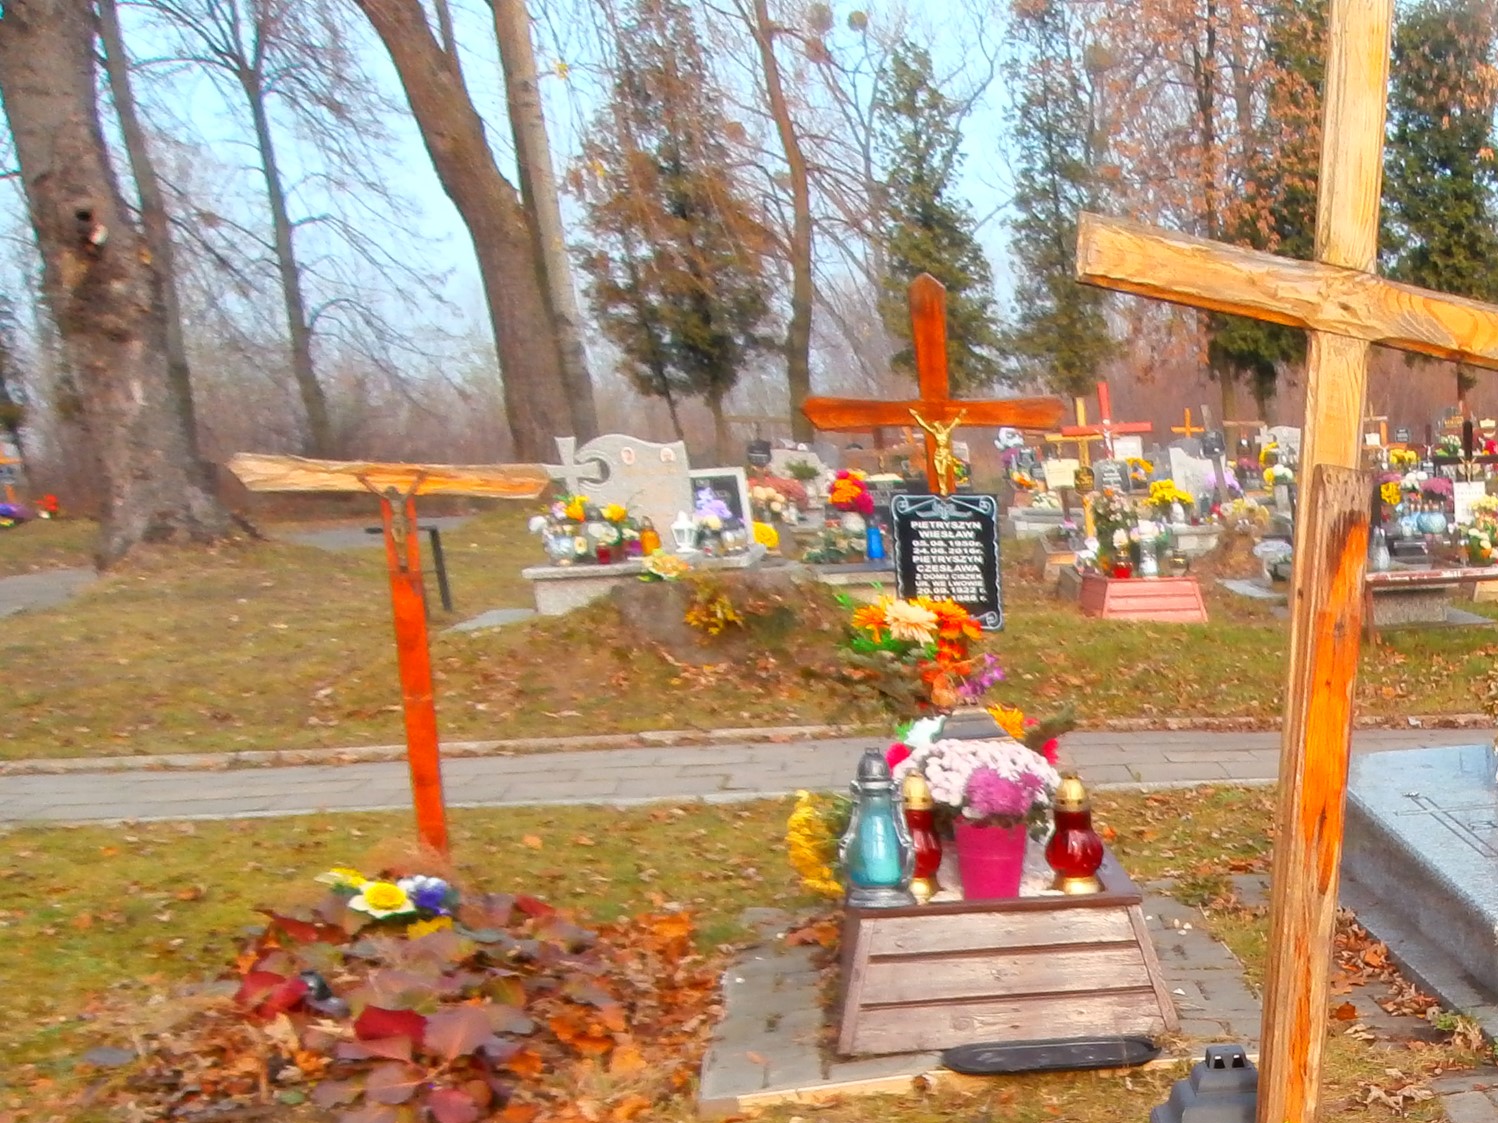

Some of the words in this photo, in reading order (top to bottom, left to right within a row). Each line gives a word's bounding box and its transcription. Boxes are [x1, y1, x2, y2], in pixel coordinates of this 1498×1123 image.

[910, 520, 983, 532] PIETRYSZYN
[918, 530, 976, 539] WIESŁAW
[911, 555, 984, 564] PIETRYSZYN
[916, 564, 981, 572] CZESŁAWA
